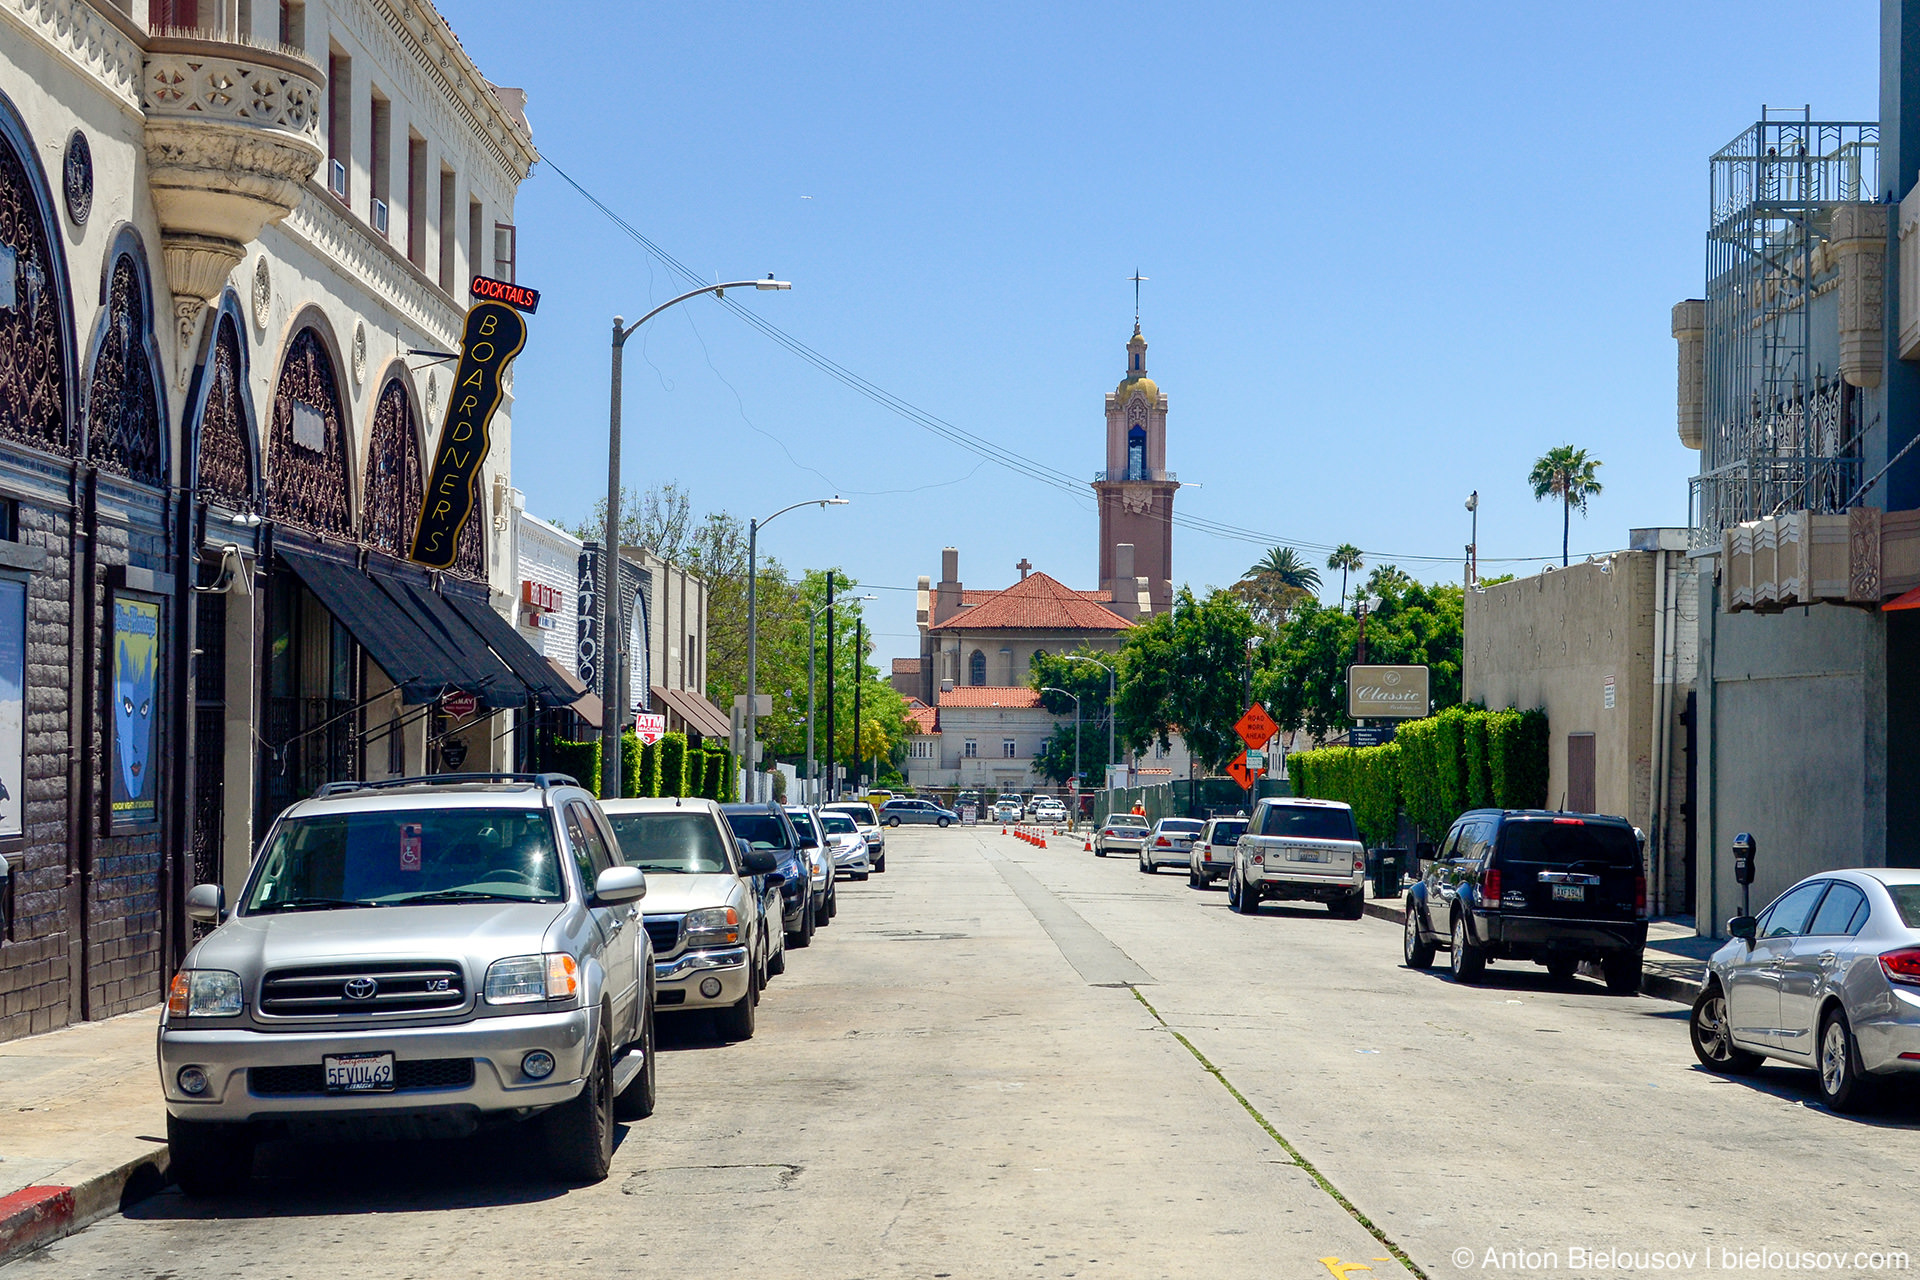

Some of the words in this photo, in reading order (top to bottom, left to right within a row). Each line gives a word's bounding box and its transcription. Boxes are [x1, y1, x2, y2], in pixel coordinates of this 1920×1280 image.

[472, 277, 534, 307] COCKTAILS
[425, 314, 498, 553] BOARDNER'S
[578, 550, 598, 686] TATTOO
[1355, 686, 1419, 701] Classic
[638, 715, 662, 728] ATM
[1247, 714, 1265, 722] ROAD
[1247, 723, 1265, 731] WORK
[1245, 732, 1266, 740] AHEAD
[426, 980, 449, 991] V8
[328, 1065, 391, 1085] 5FVU469
